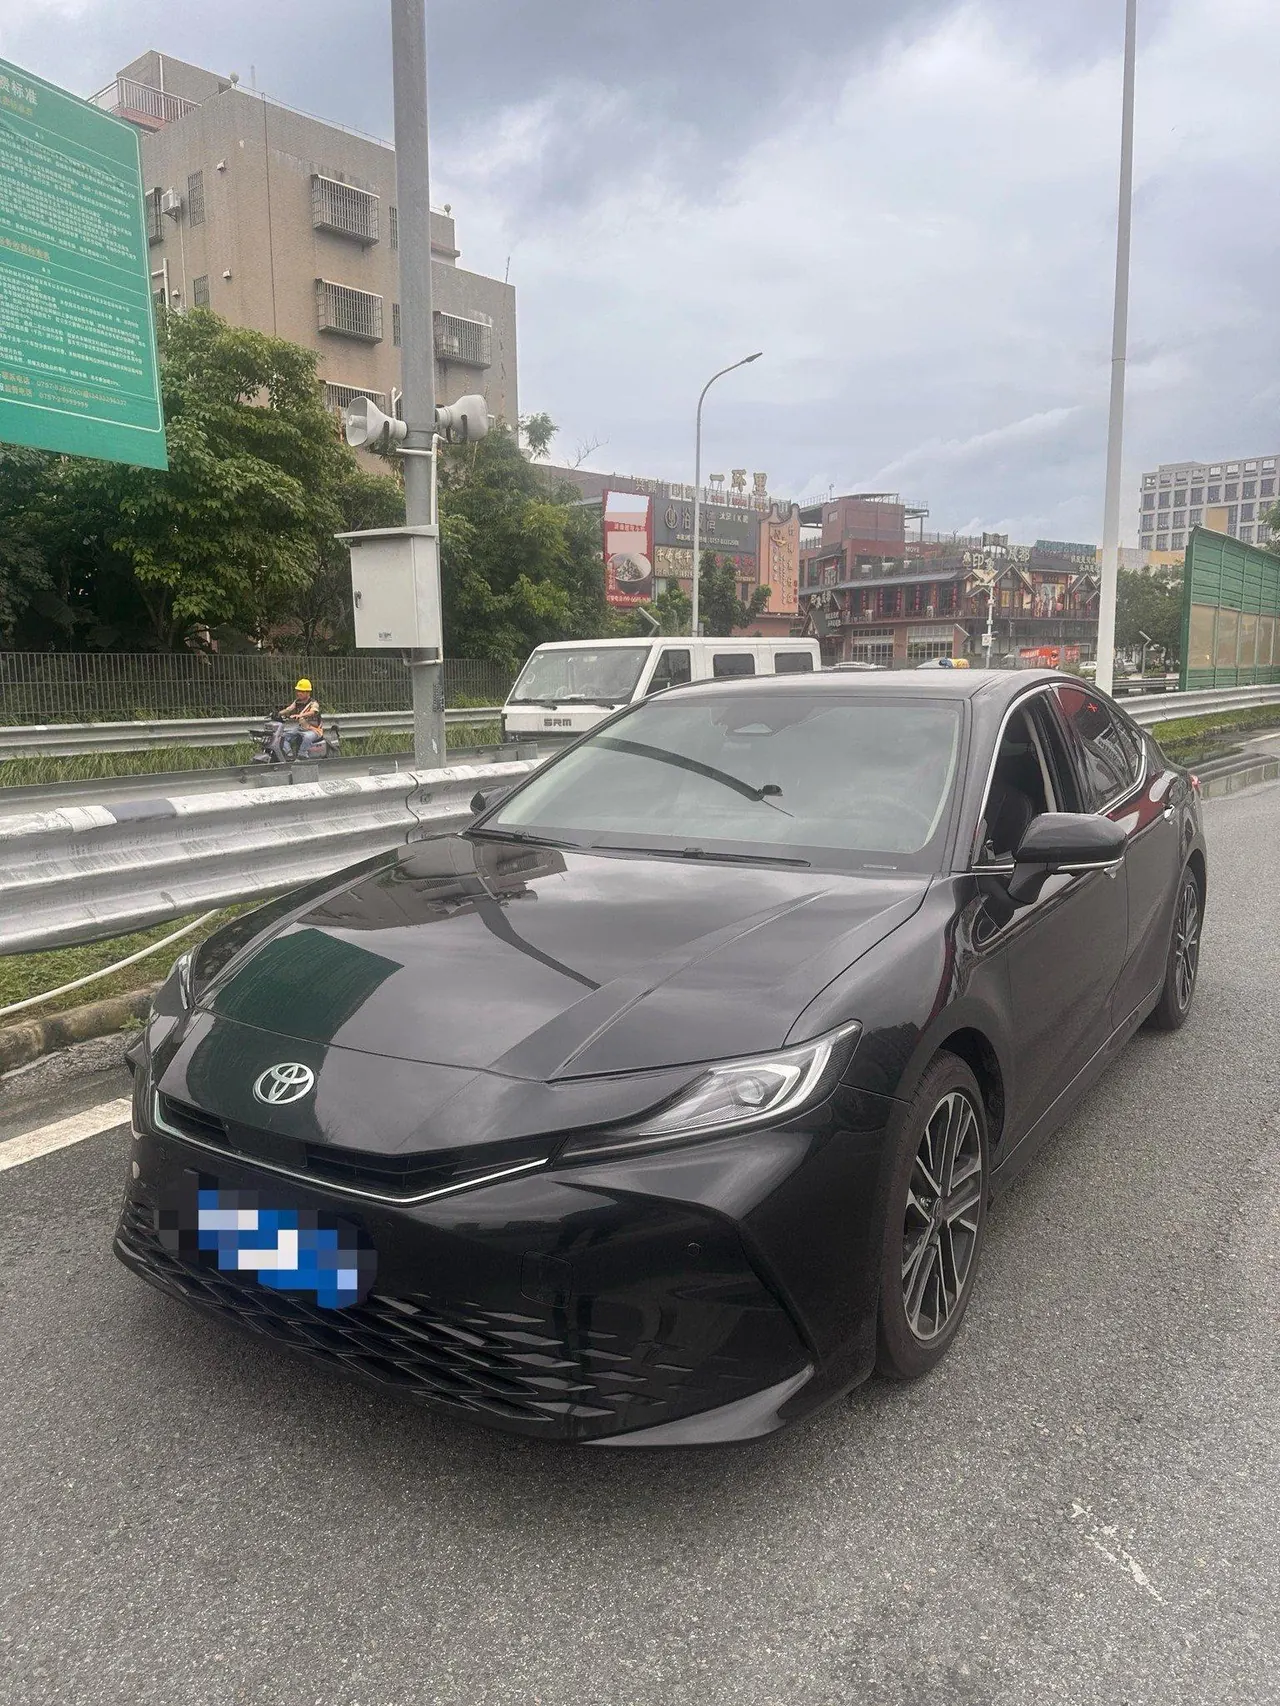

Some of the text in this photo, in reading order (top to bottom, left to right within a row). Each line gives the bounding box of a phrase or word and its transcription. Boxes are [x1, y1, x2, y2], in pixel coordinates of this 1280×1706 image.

[709, 469, 768, 496] 一环里
[543, 718, 572, 727] SRM
